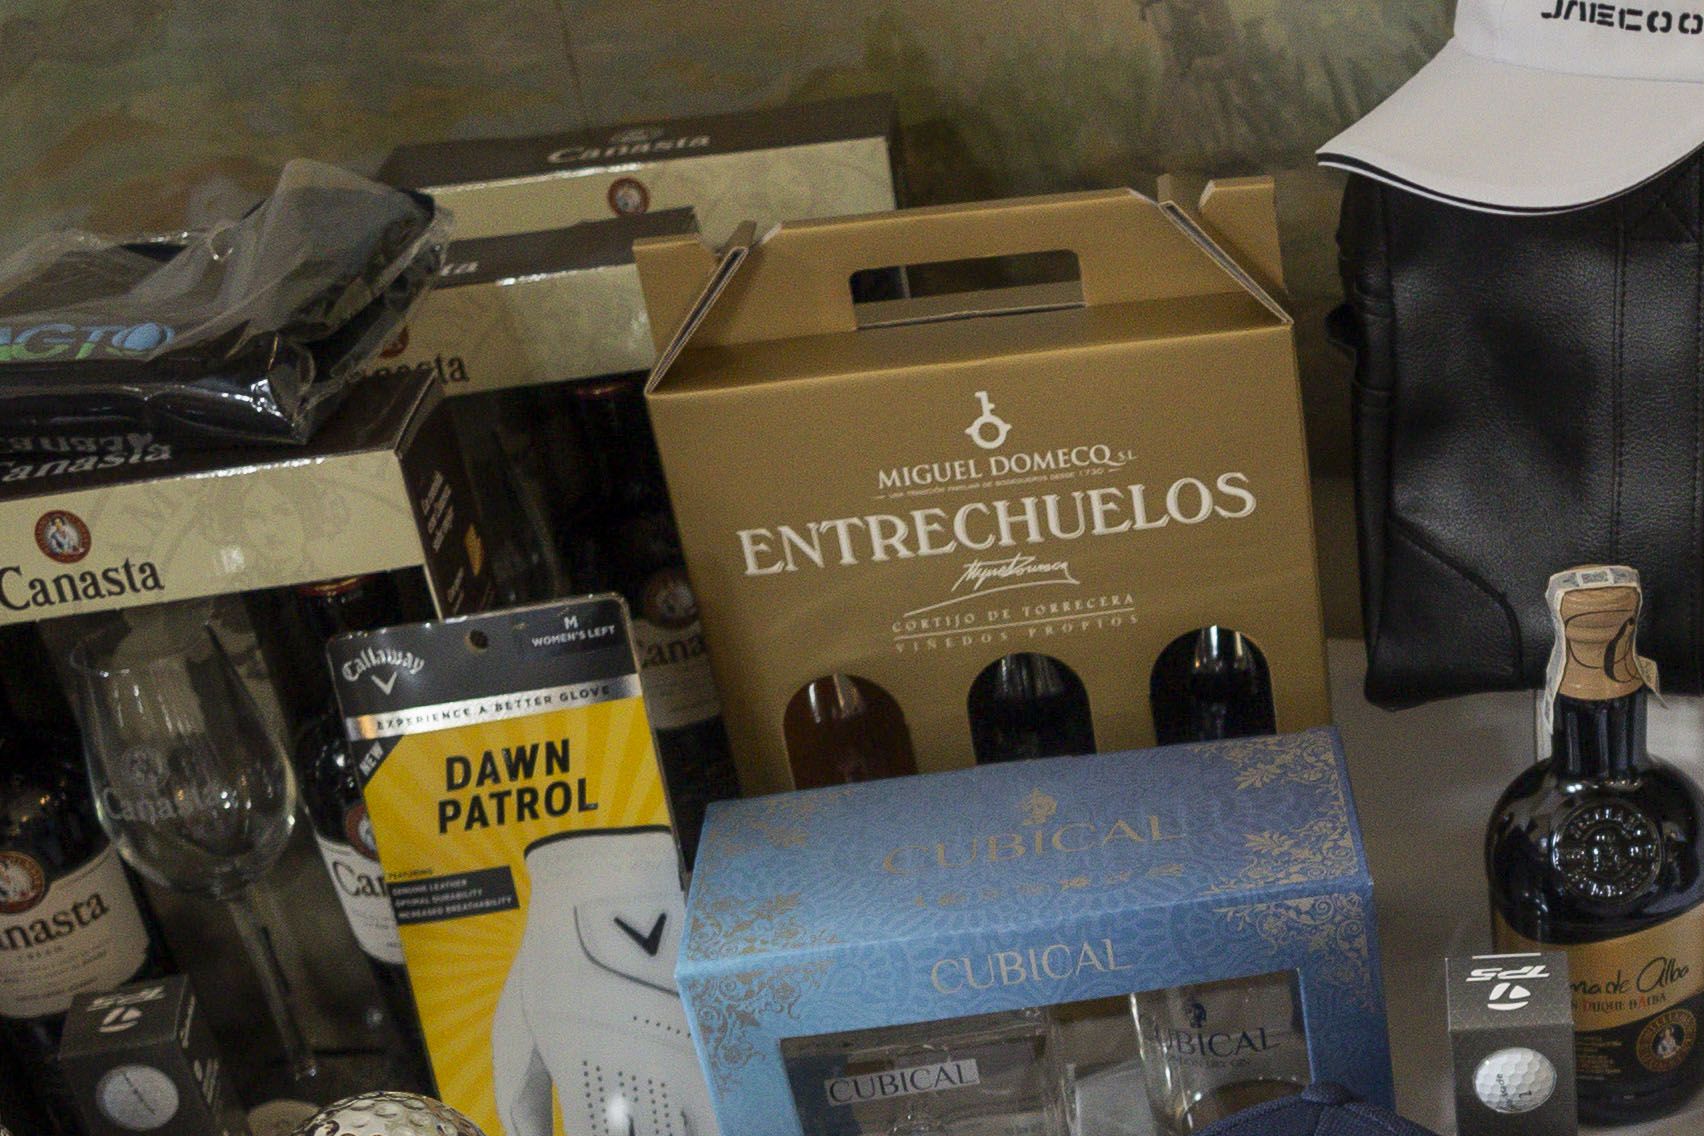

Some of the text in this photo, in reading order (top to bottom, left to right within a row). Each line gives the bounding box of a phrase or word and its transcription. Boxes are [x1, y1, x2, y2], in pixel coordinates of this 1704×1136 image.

[1541, 0, 1704, 34] JAECOO
[0, 443, 173, 482] anasta
[878, 444, 1126, 489] MIGUEL DOMECQ
[736, 472, 1257, 577] ENTRECHUELOS
[0, 557, 165, 611] Canasta
[564, 615, 578, 629] M
[891, 593, 1134, 633] CORTIJO DE TORRECERA
[532, 625, 616, 648] WOMEN'S LEFT
[342, 647, 425, 682] Callaway
[376, 685, 609, 730] EXPERIENCE A BETTER GLOVE
[359, 741, 384, 774] NEW
[445, 738, 571, 792] DAWN
[438, 778, 599, 836] PATROL
[882, 816, 1184, 875] CUBICAL
[0, 893, 109, 950] nasta
[931, 938, 1133, 994] CUBICAL
[1605, 969, 1630, 994] de
[1636, 956, 1690, 993] Alba
[1153, 1023, 1281, 1057] UBICAL
[829, 1063, 978, 1102] CUBICAL
